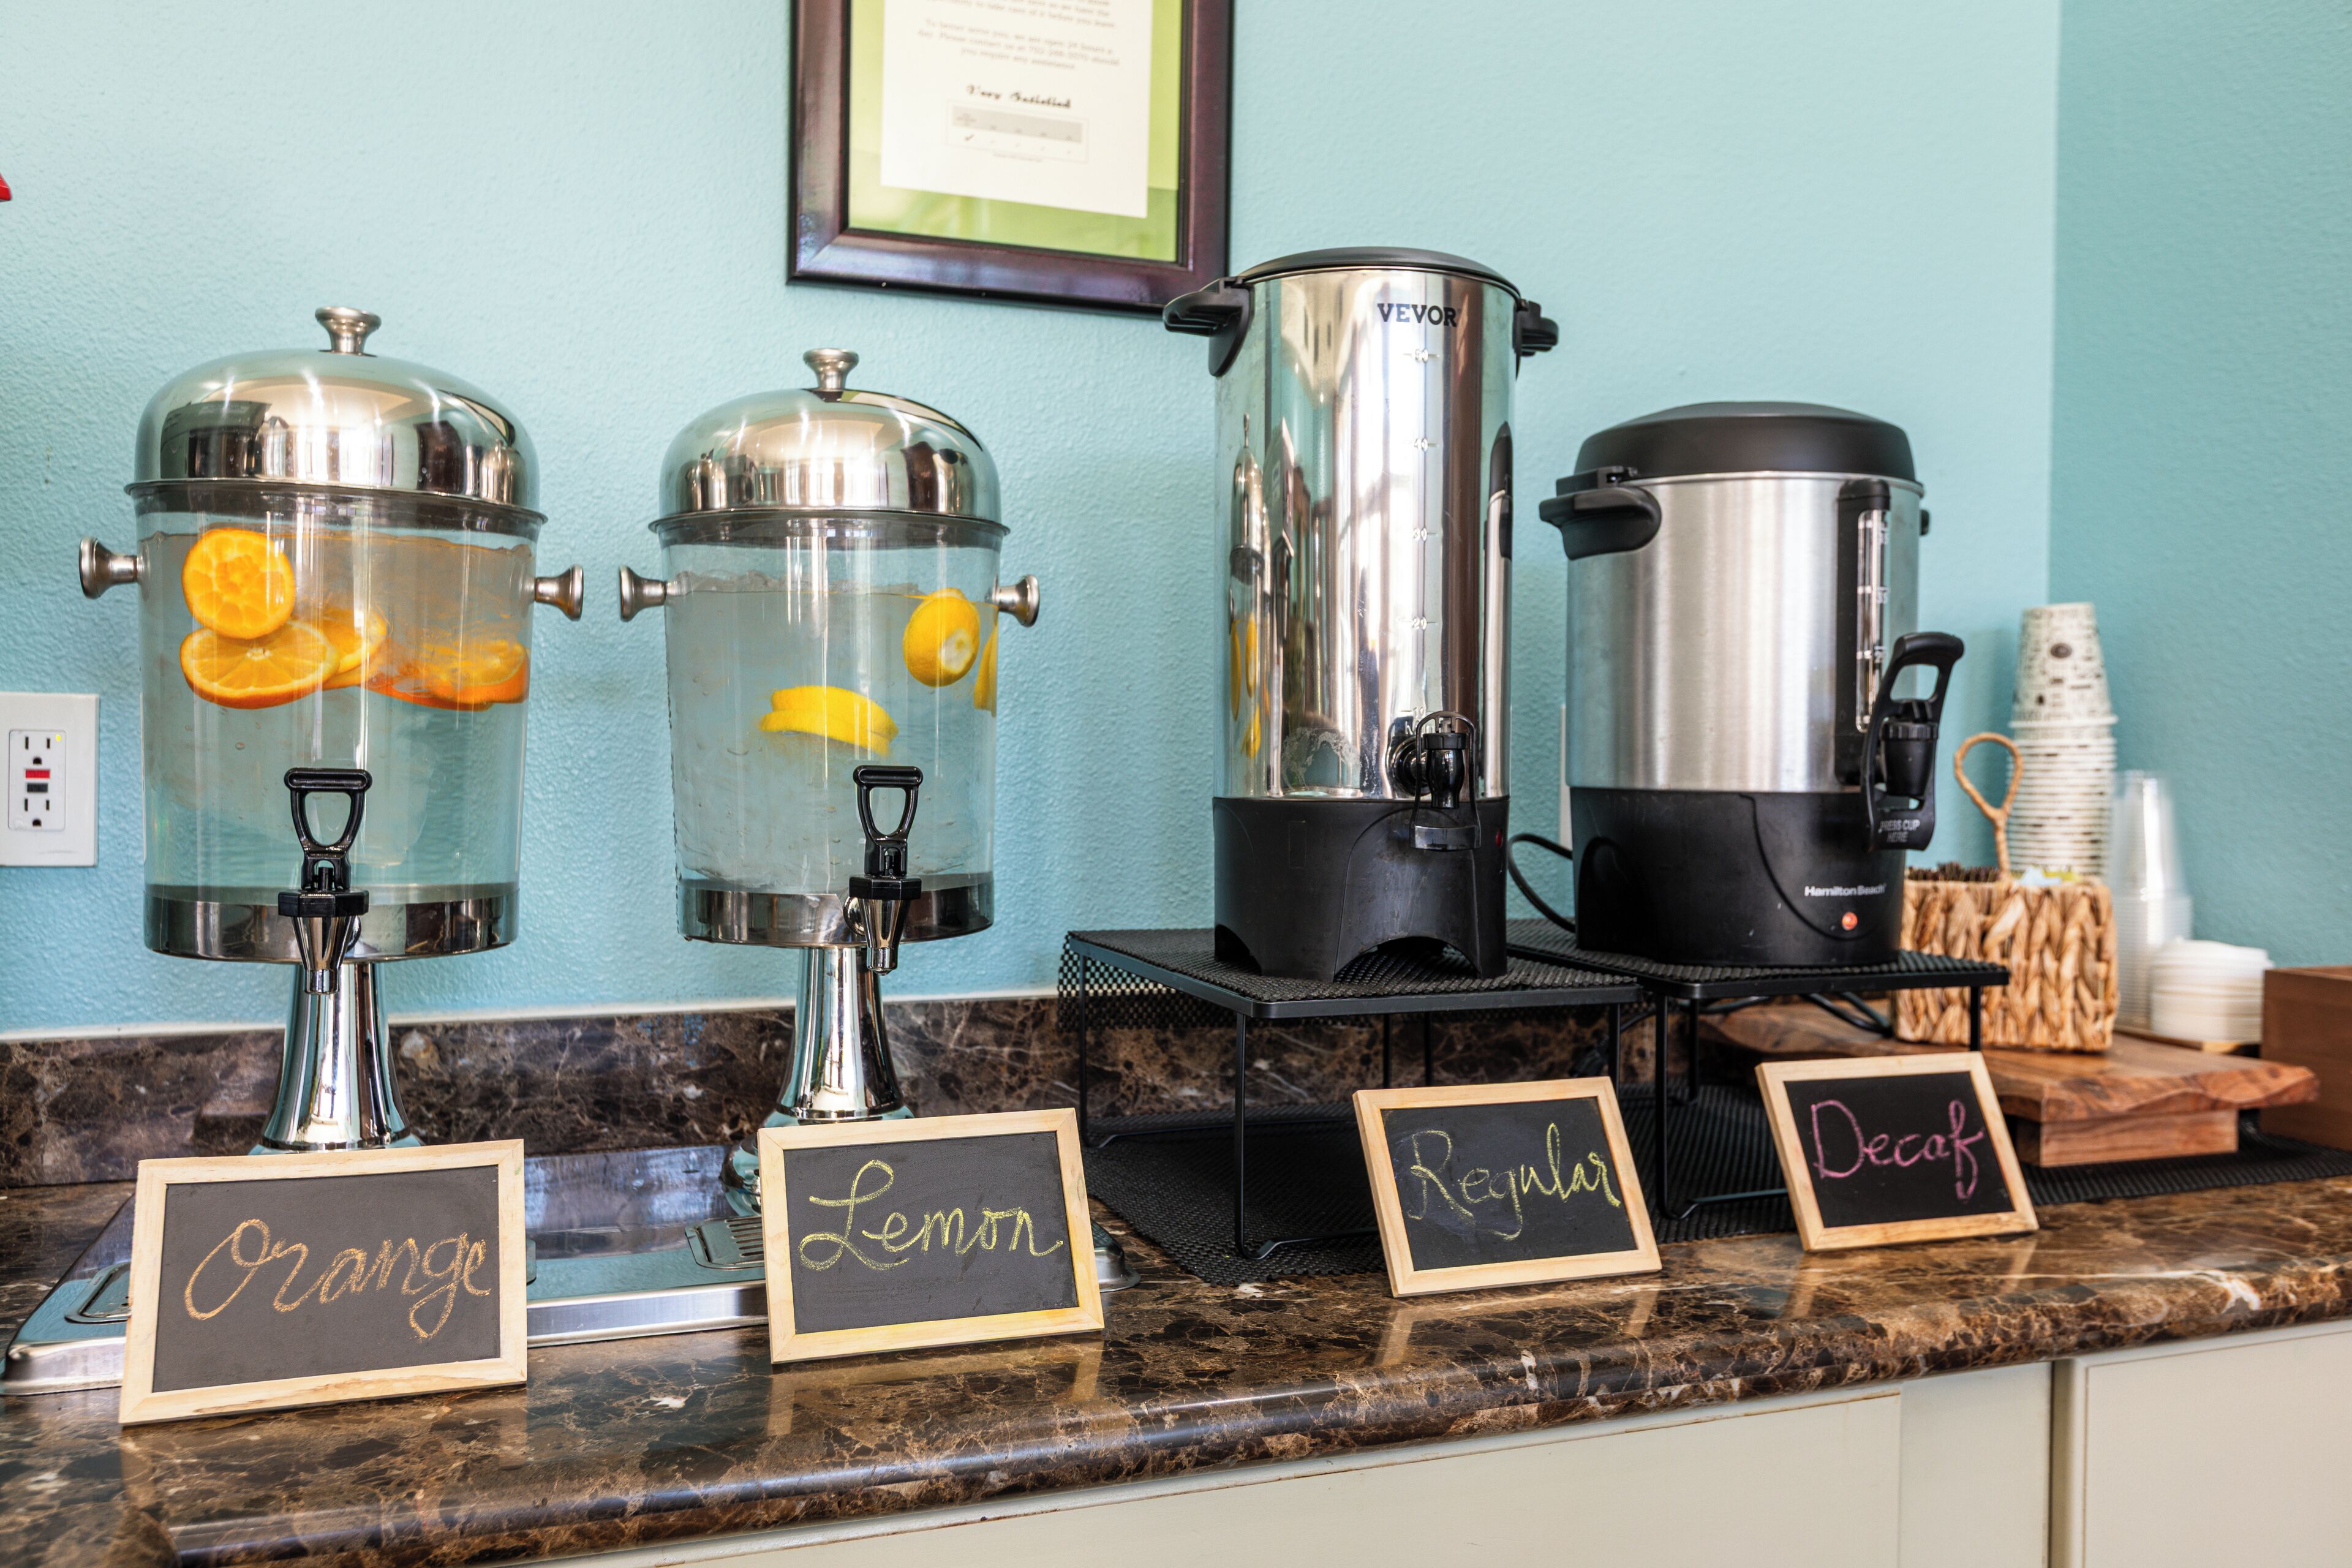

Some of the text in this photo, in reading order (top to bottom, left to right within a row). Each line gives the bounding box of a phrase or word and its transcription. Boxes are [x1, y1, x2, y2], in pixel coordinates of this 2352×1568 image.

[1378, 303, 1457, 328] VEVOR
[1902, 818, 1921, 831] CUP
[1804, 886, 1857, 897] Hamilton
[1409, 1123, 1621, 1242] Regular
[1811, 1099, 1985, 1203] Decaf
[798, 1159, 1064, 1271] Lemon
[184, 1218, 492, 1343] Orange
